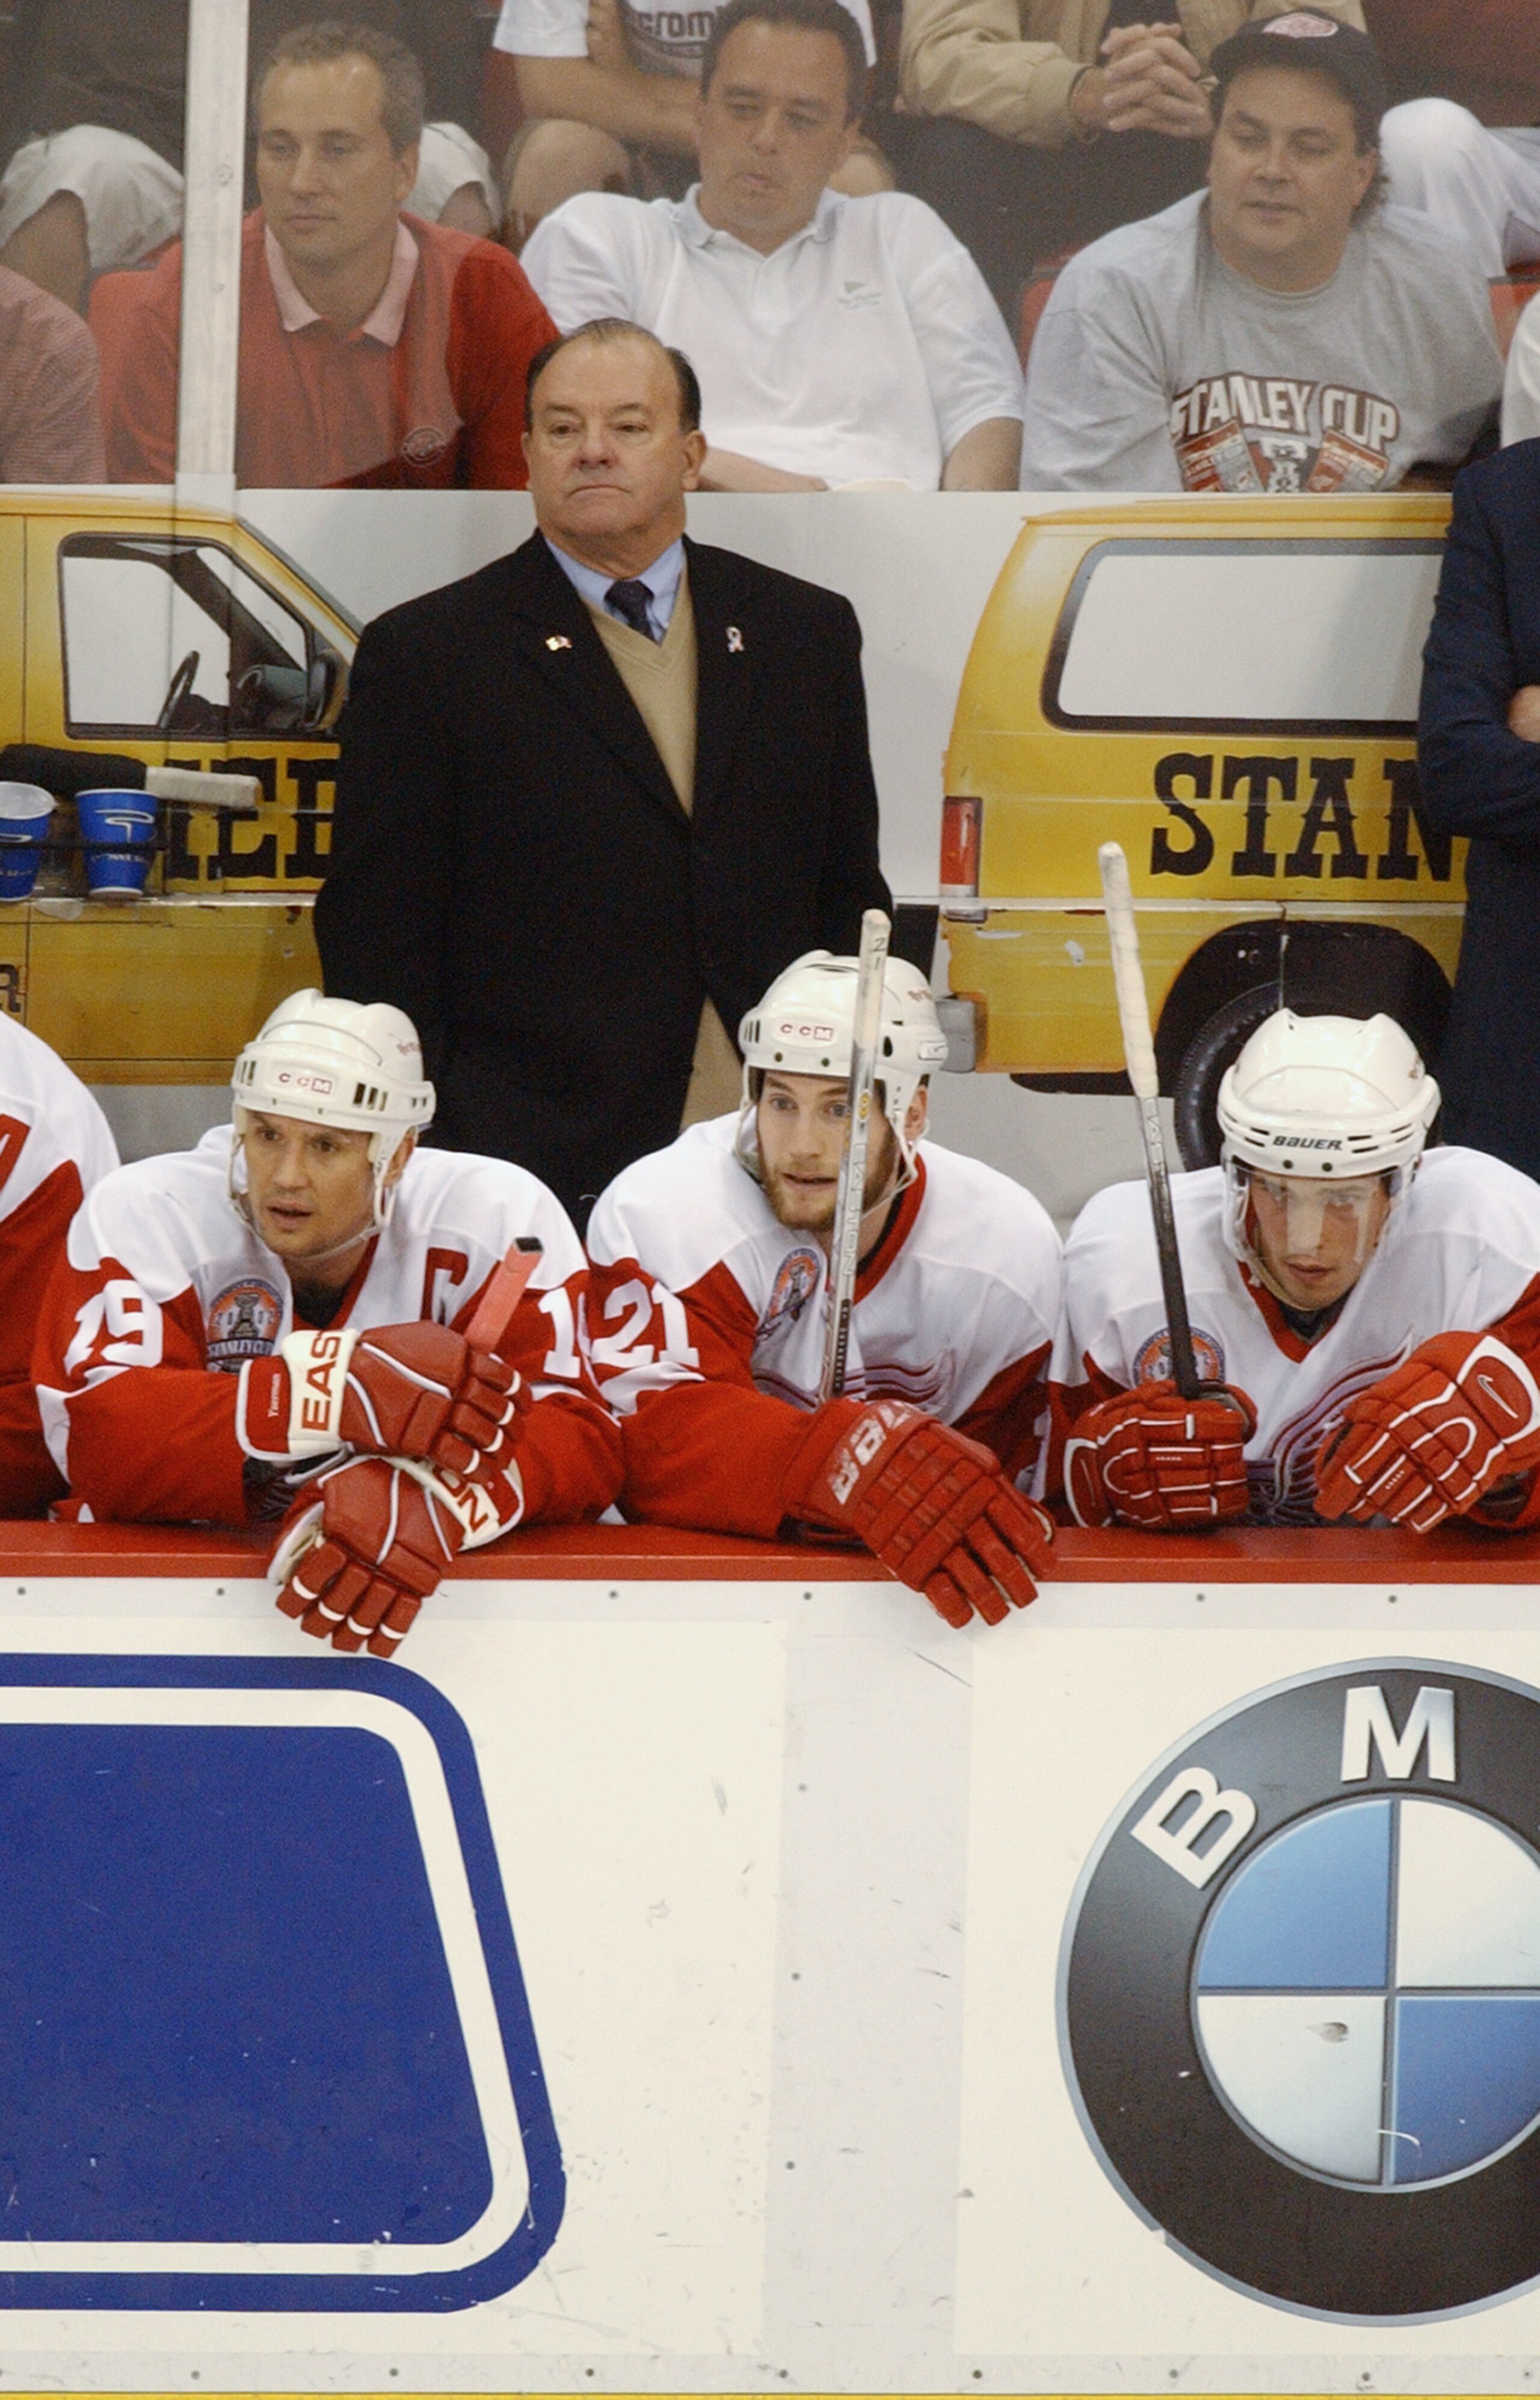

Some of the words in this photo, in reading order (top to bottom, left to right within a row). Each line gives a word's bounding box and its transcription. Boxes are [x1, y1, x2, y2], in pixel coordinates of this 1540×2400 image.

[634, 5, 725, 37] crom
[1171, 374, 1314, 443] STANLEY
[1322, 386, 1399, 454] CUP
[1150, 753, 1452, 881] STAN
[780, 1023, 834, 1041] CCM
[279, 1072, 333, 1095] CCM
[1272, 1135, 1343, 1152] BAUER
[63, 1279, 163, 1376] 19
[538, 1286, 592, 1378] 1
[591, 1278, 700, 1369] 21
[302, 1330, 341, 1431] EAS
